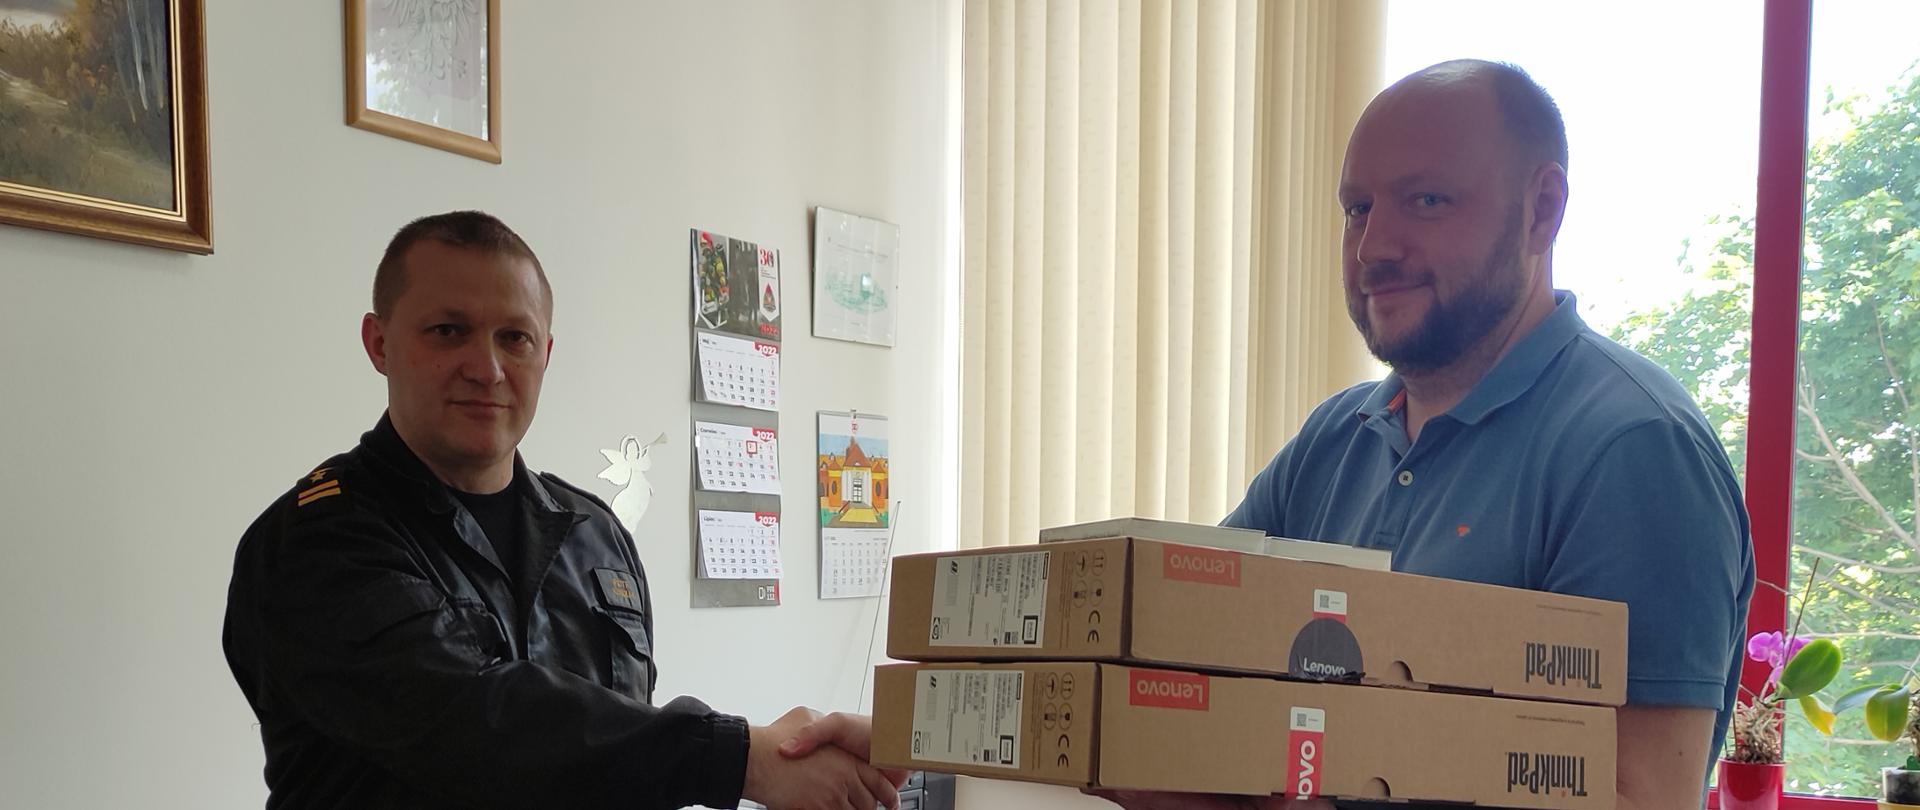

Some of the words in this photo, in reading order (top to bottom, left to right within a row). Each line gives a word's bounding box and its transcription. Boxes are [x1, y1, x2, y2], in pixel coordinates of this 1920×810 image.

[757, 344, 777, 354] 2022
[756, 431, 775, 440] 2022
[758, 516, 777, 525] 2022
[1170, 553, 1235, 579] Lenovo
[1303, 657, 1346, 676] Lenovo
[1525, 642, 1602, 689] ThinkPad
[1136, 679, 1203, 704] Lenovo
[1507, 752, 1588, 797] ThinkPad
